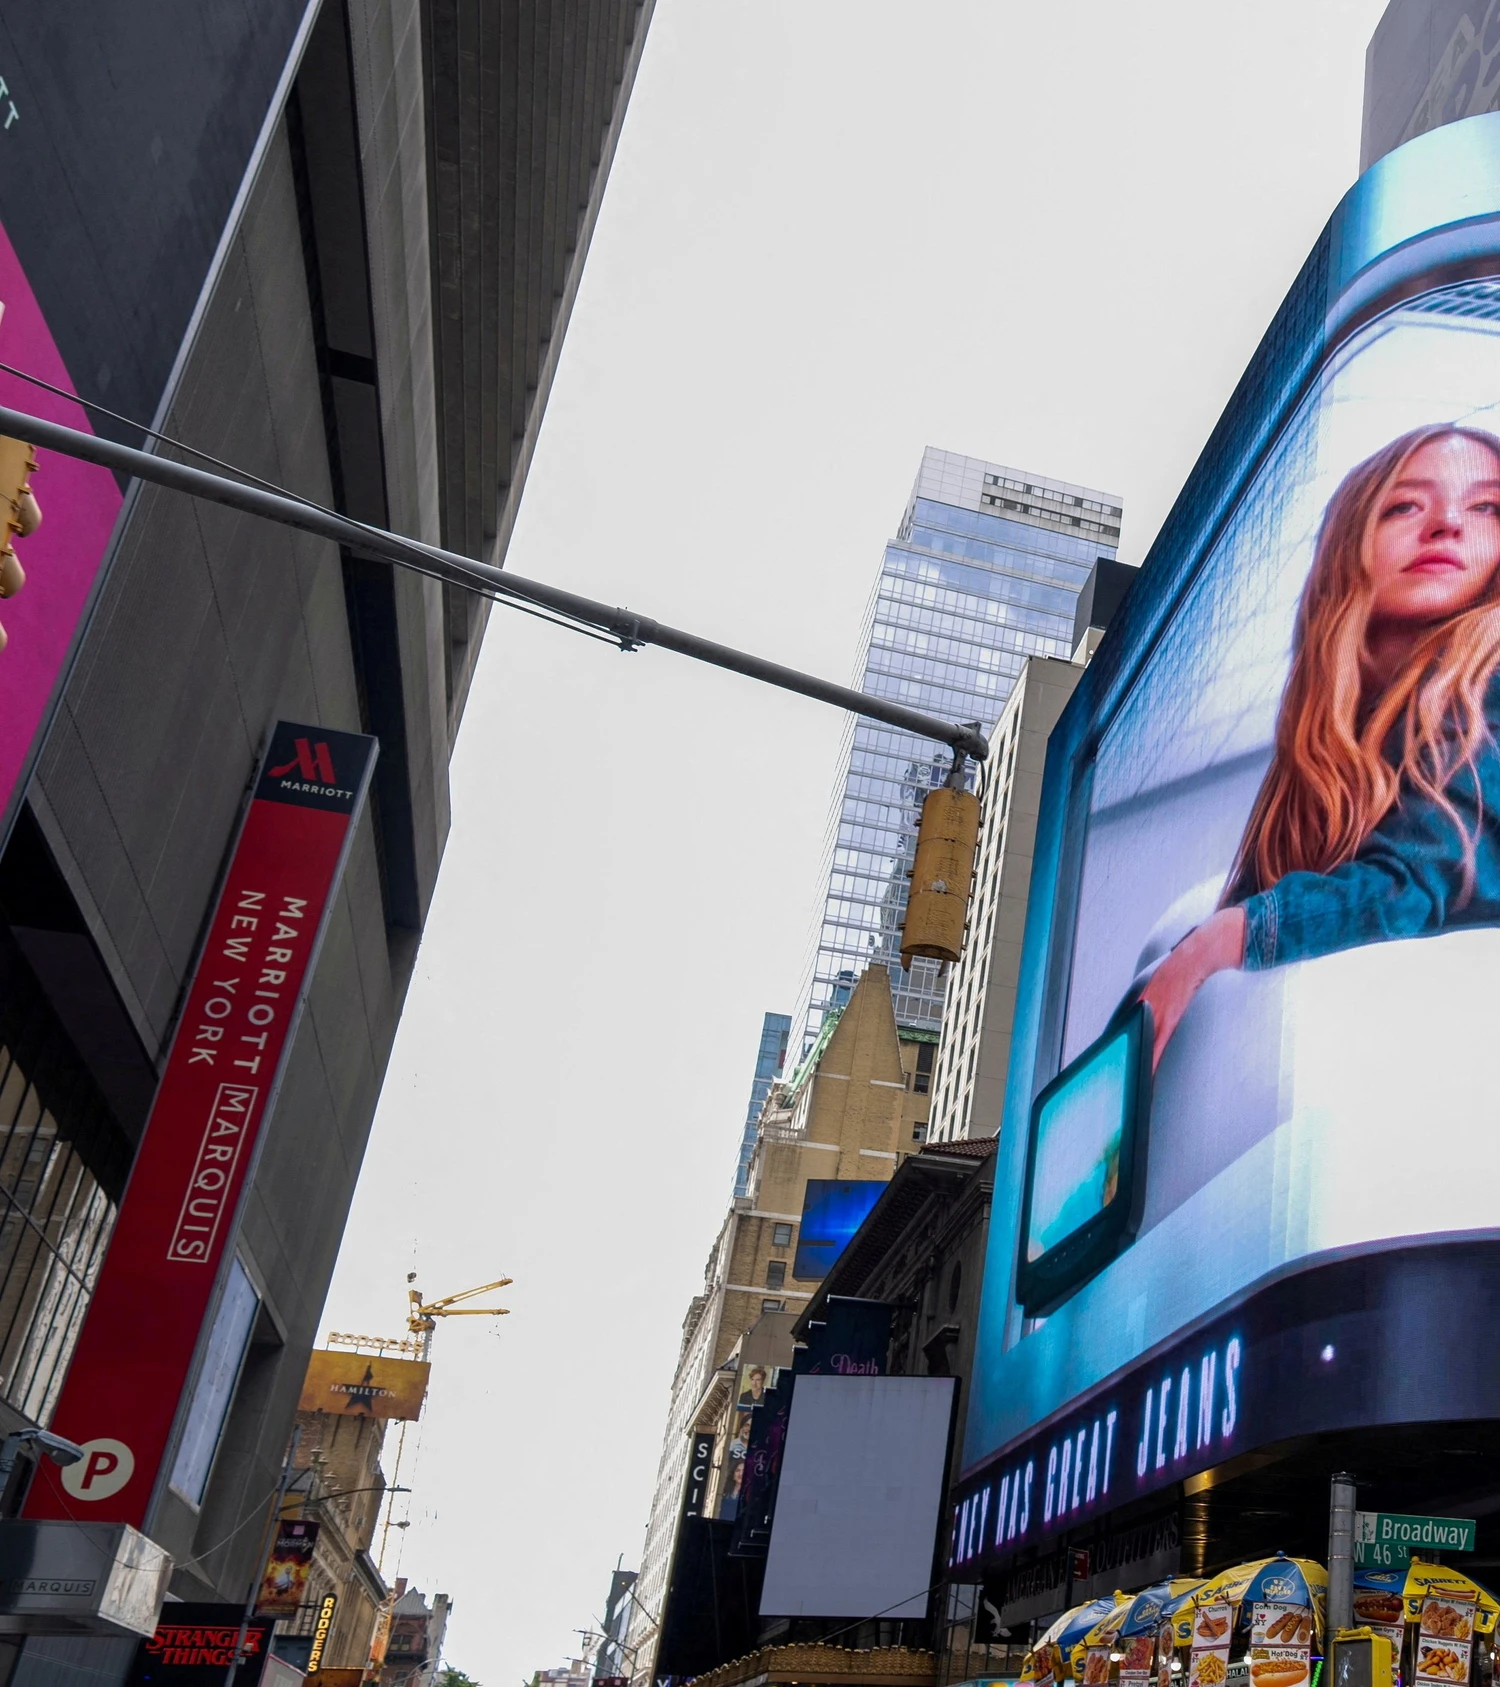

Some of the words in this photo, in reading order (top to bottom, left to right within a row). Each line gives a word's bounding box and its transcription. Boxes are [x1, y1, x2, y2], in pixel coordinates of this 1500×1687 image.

[280, 780, 354, 800] MARRIOTT
[222, 890, 267, 963] NEW
[233, 896, 308, 1074] MARRIOTT
[188, 977, 241, 1066] YORK
[175, 1089, 251, 1256] MARQUIS
[327, 1331, 424, 1354] RODGERS
[329, 1384, 398, 1398] HAMILTON
[949, 1486, 990, 1568] NEY
[995, 1460, 1033, 1546] HAS
[1043, 1410, 1117, 1523] GREAT
[1137, 1337, 1241, 1478] JEANS
[80, 1451, 119, 1490] P
[687, 1442, 709, 1517] SCI
[1381, 1518, 1469, 1550] Broadway
[1373, 1543, 1392, 1565] 46
[1397, 1545, 1407, 1558] St
[12, 1580, 92, 1594] MARQUIS
[1208, 1605, 1228, 1613] Churros
[1254, 1603, 1273, 1611] Corn
[1273, 1604, 1288, 1612] Dog
[307, 1597, 335, 1673] RODGERS
[1284, 1650, 1298, 1658] Dog
[1228, 1667, 1249, 1679] HALAL
